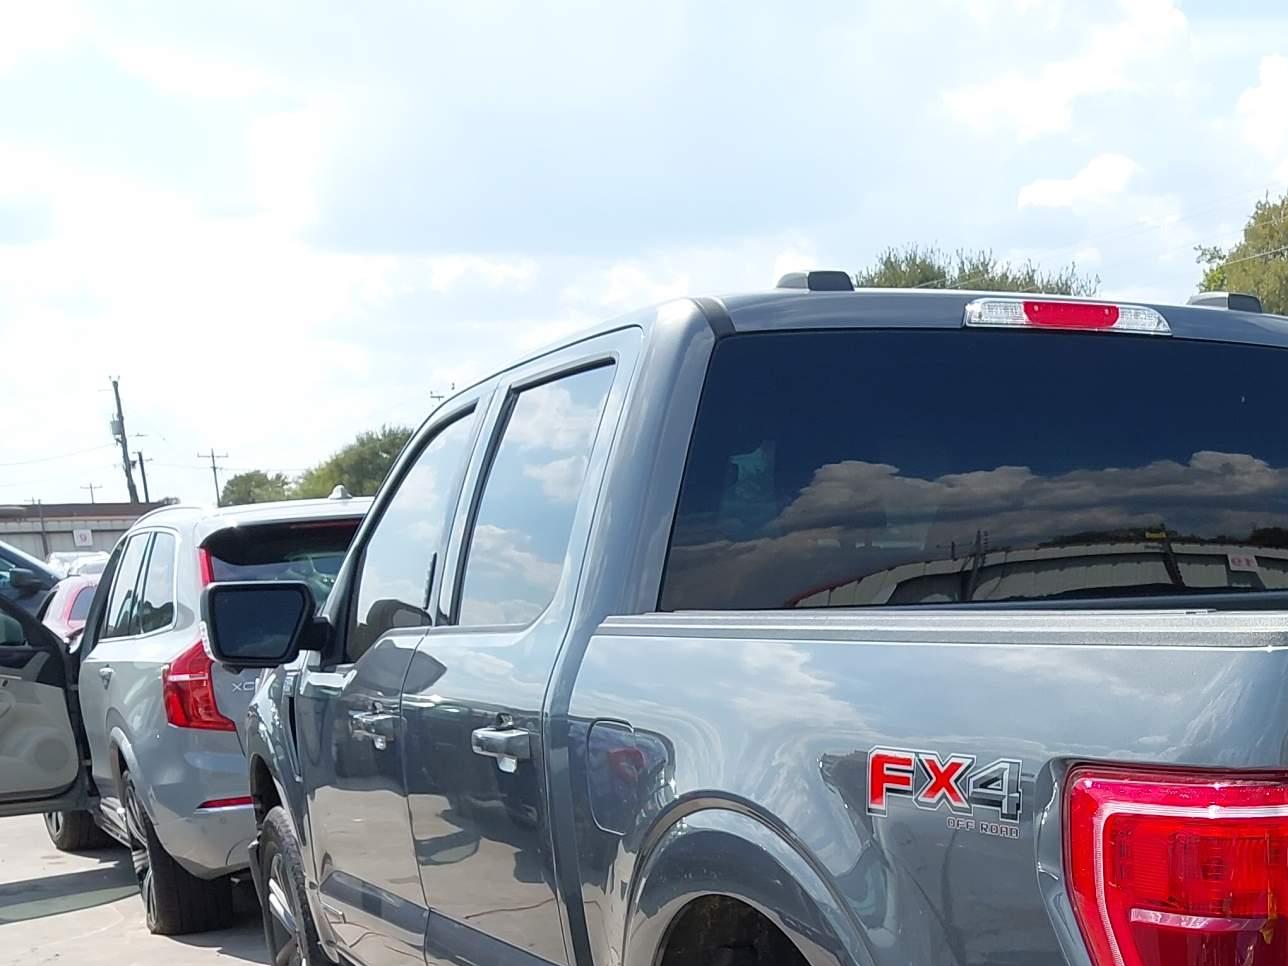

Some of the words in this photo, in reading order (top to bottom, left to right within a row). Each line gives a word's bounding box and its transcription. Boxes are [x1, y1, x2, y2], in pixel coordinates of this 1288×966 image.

[866, 745, 1023, 823] FX4
[946, 816, 977, 831] OFF
[979, 821, 1020, 840] ROAD
